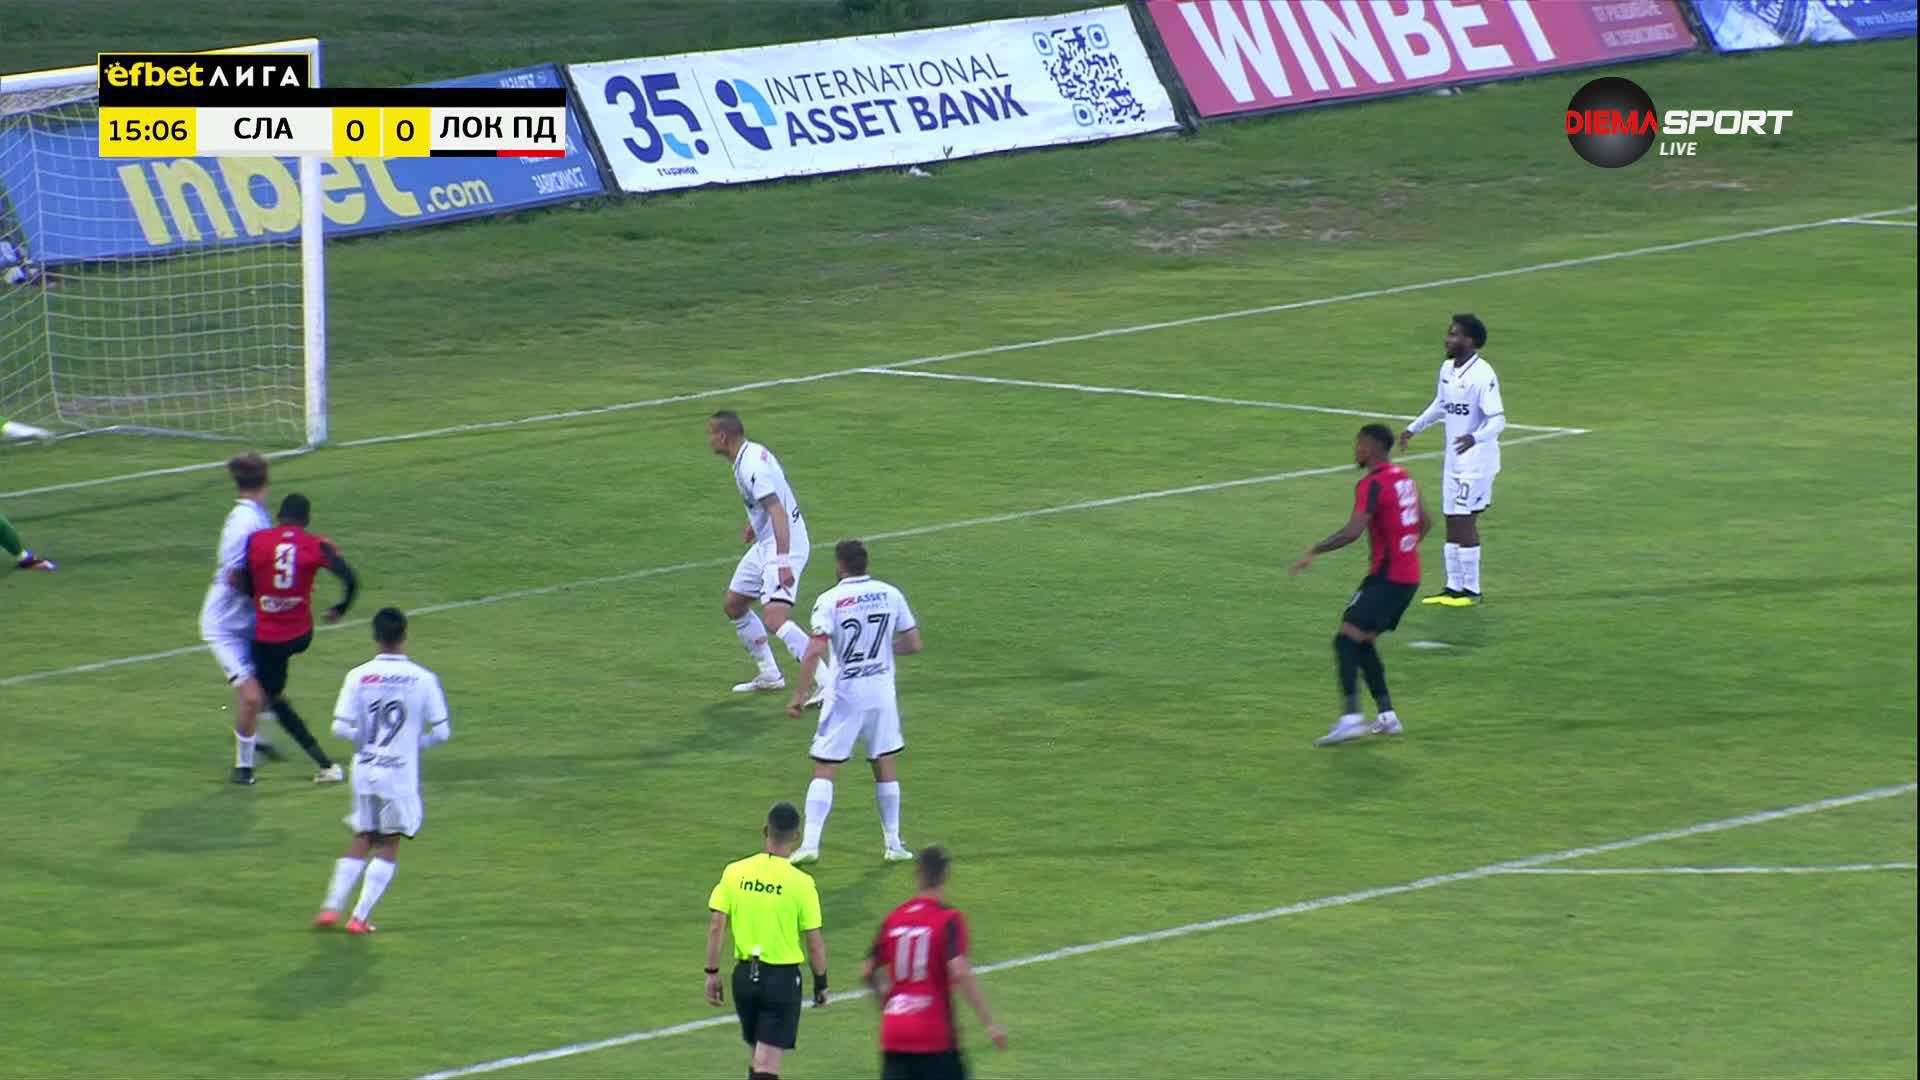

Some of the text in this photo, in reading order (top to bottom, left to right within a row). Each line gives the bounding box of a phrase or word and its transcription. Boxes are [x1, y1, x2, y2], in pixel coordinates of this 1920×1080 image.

[1177, 0, 1557, 103] WINBET
[765, 53, 1009, 106] INTERNATIONAL
[785, 84, 1029, 147] ASSET BANK
[273, 543, 297, 590] 9
[840, 612, 890, 665] 27
[368, 699, 408, 748] 19
